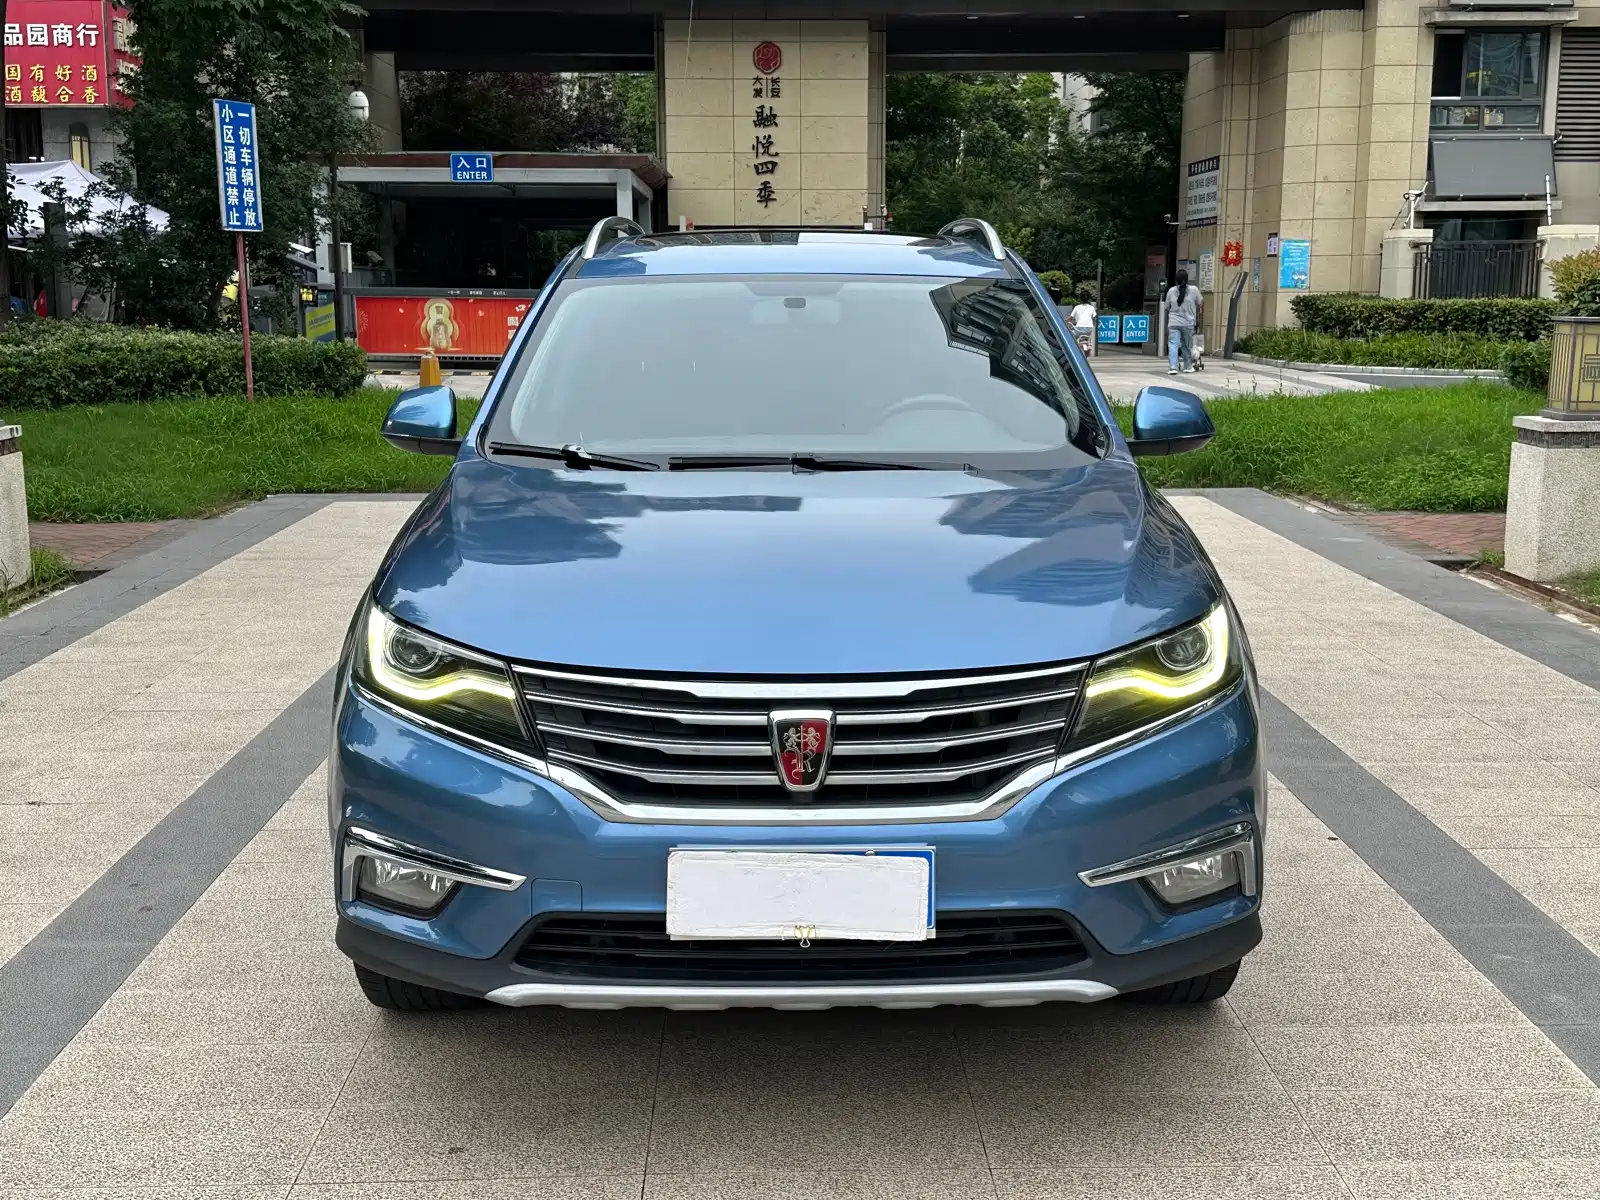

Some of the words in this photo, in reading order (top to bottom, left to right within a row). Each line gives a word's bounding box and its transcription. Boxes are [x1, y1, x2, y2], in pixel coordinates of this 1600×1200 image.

[4, 23, 99, 46] 品园商行
[5, 64, 98, 82] 国有好酒
[457, 156, 487, 168] 入口
[752, 105, 780, 208] 融悦四季
[221, 104, 241, 226] 小区通道禁止
[237, 112, 257, 226] 一切车辆停放
[456, 171, 488, 180] ENTER
[1097, 319, 1116, 329] 入口
[1127, 319, 1147, 329] 入口
[1126, 330, 1146, 338] ENTER
